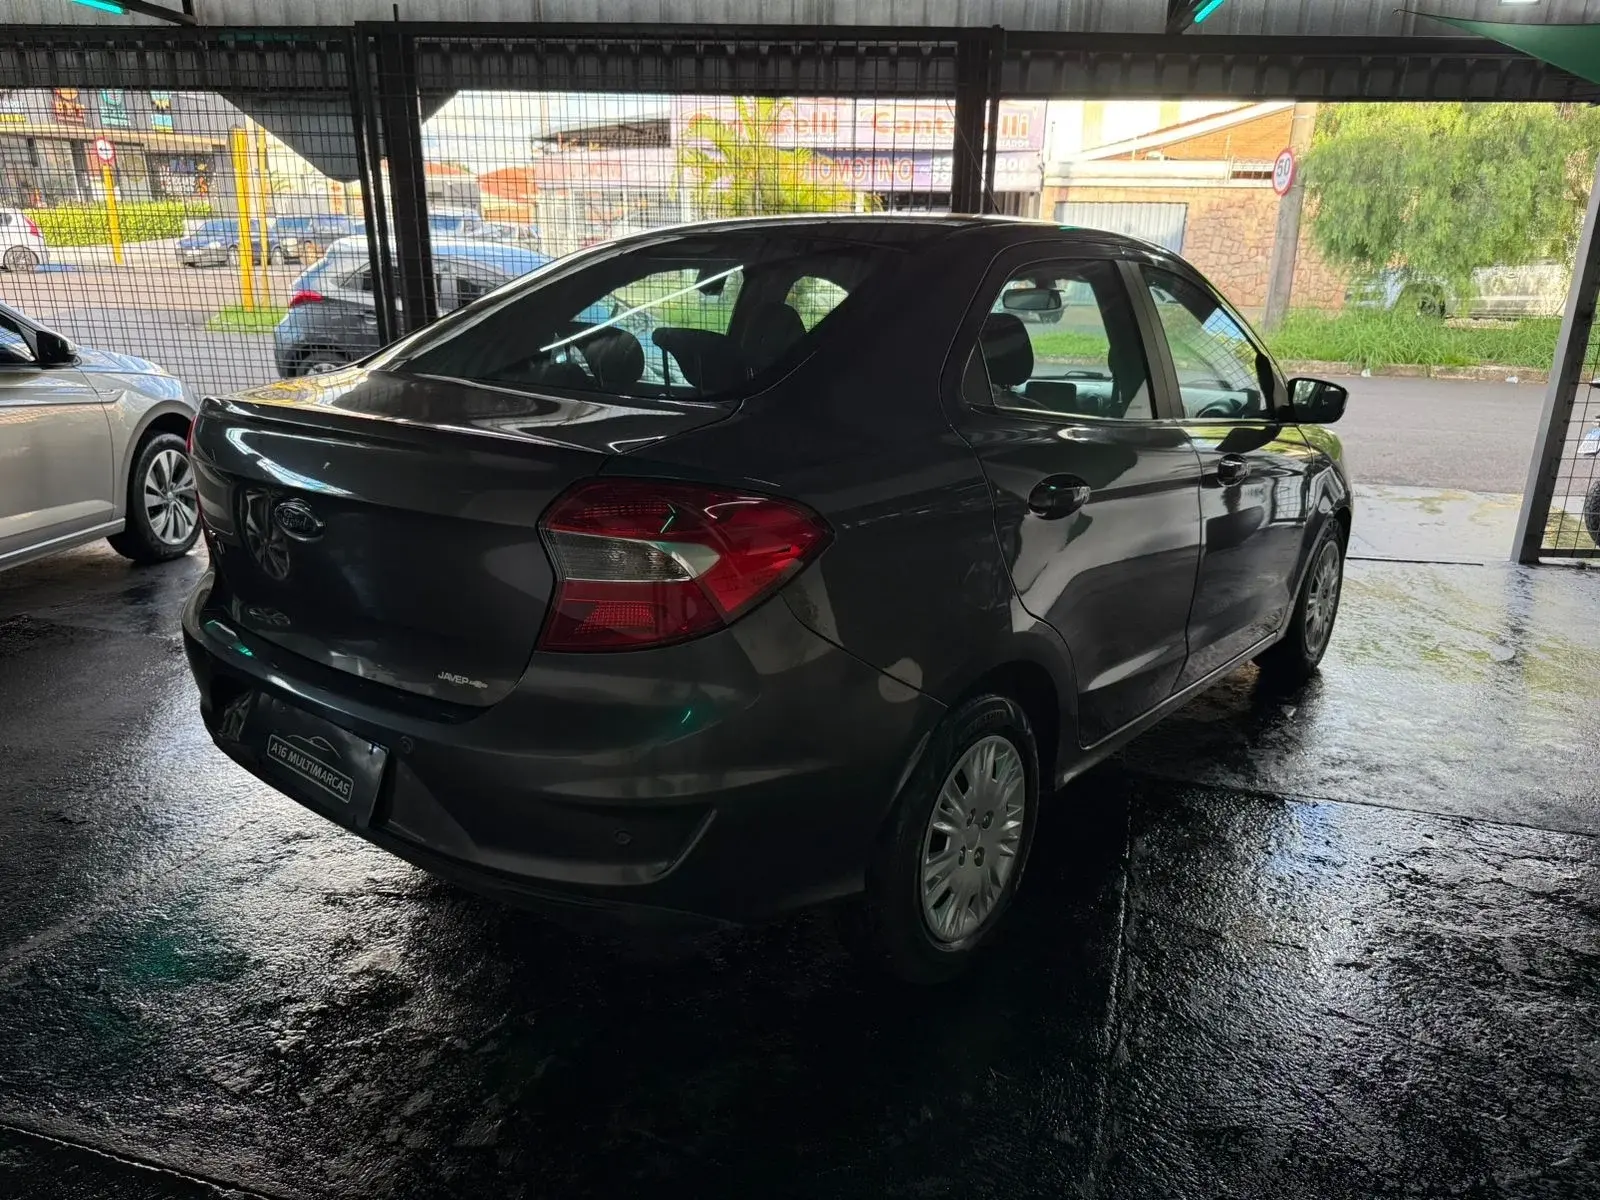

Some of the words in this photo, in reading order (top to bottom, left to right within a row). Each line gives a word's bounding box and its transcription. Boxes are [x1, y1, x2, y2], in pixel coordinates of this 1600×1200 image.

[1276, 157, 1291, 177] 50
[437, 671, 469, 685] JAVEP
[271, 743, 287, 758] A16
[287, 750, 350, 796] MULTIMARCAS
